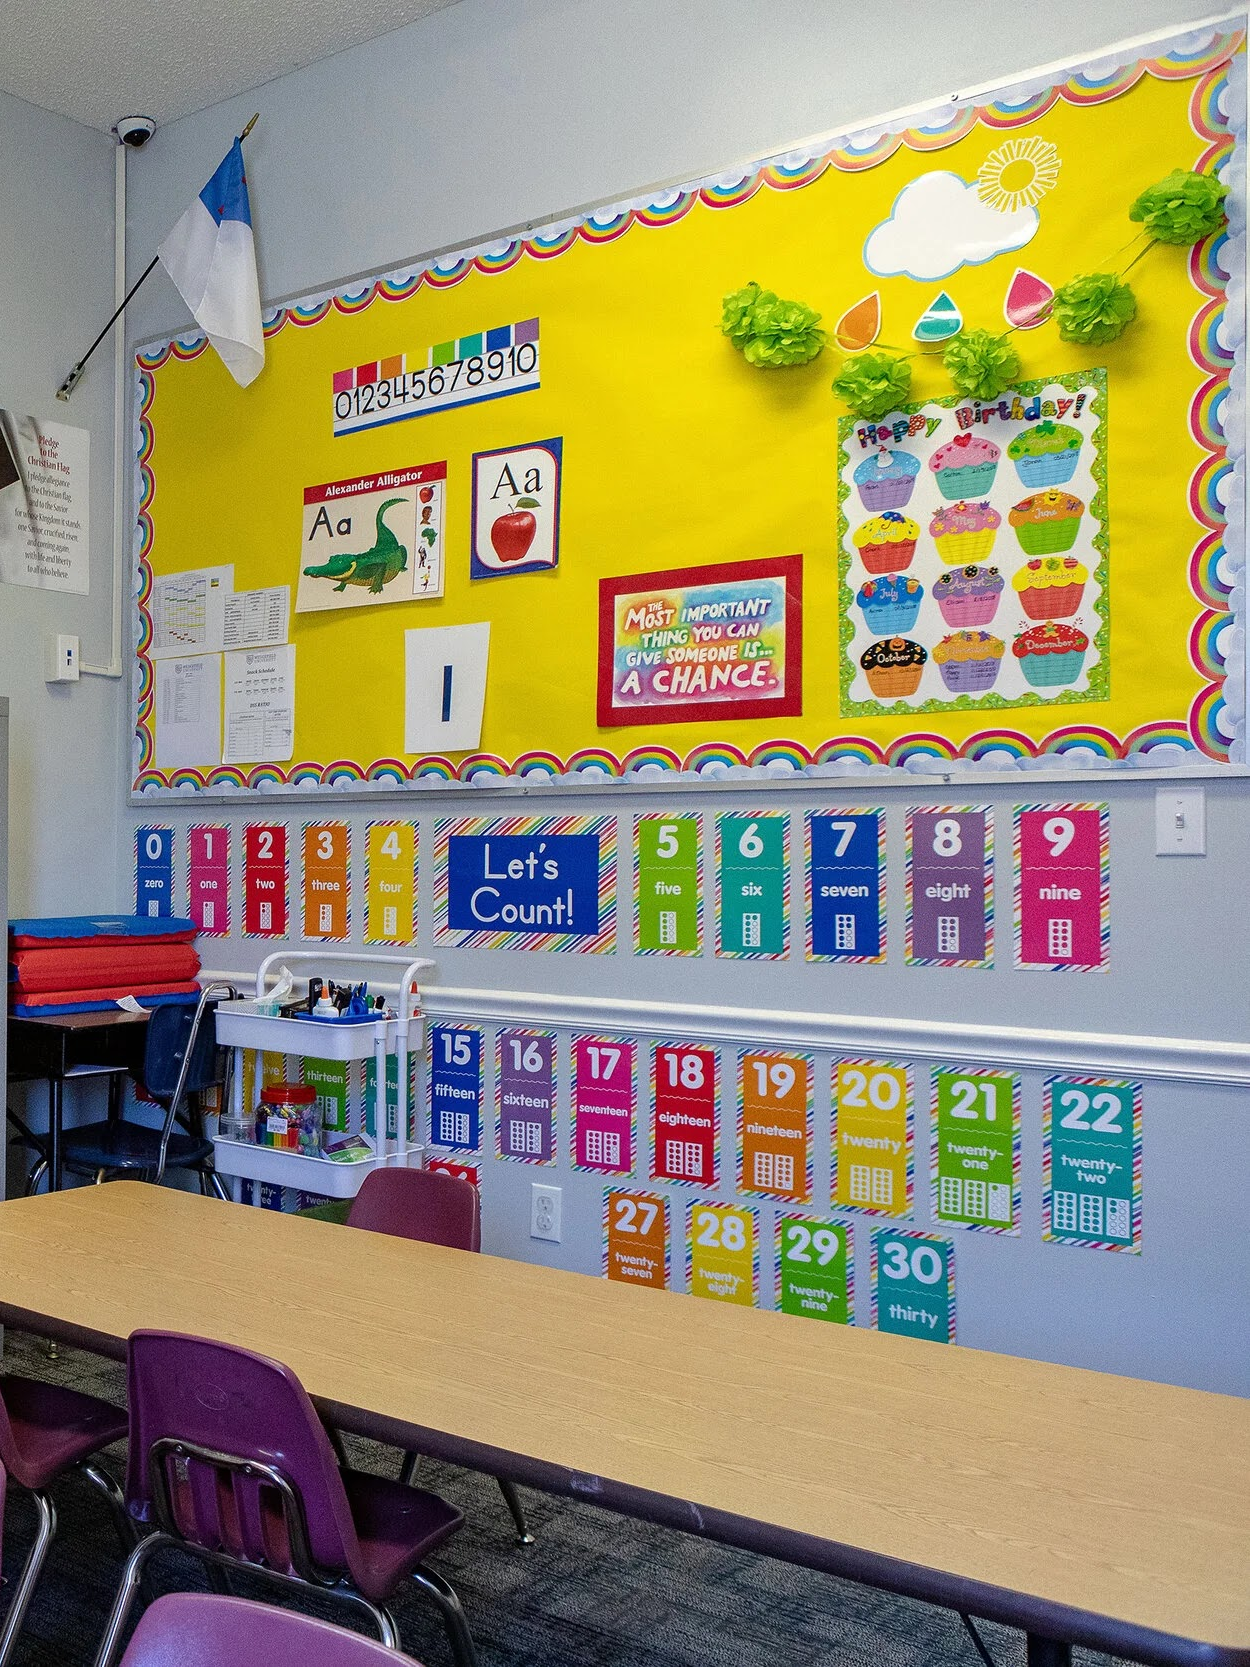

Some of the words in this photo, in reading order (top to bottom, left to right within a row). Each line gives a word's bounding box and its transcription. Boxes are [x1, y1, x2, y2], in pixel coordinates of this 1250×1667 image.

[857, 414, 942, 448] Happy
[955, 393, 1087, 430] Birthday!
[39, 435, 59, 449] Pledge
[40, 448, 47, 457] to
[48, 449, 59, 459] the
[27, 455, 57, 470] Christian
[57, 462, 70, 475] Flag
[325, 479, 374, 497] Alexander
[377, 470, 423, 489] Alligator
[490, 462, 543, 500] Aa
[309, 506, 352, 542] Aa
[952, 514, 977, 529] May
[1034, 508, 1057, 519] June
[872, 529, 898, 542] April
[949, 579, 985, 597] August
[1027, 572, 1077, 587] September
[880, 587, 899, 601] July
[624, 606, 675, 631] MOST
[681, 598, 772, 623] IMPORTANT
[648, 601, 663, 613] THE
[642, 629, 688, 648] THING
[692, 626, 722, 642] YOU
[726, 622, 760, 639] CAN
[1025, 639, 1073, 650] December
[625, 649, 662, 667] GIVE
[665, 644, 738, 664] SOMEONE
[743, 641, 773, 659] IS...
[877, 653, 911, 663] October
[620, 670, 641, 695] A
[652, 660, 776, 693] CHANCE.
[146, 833, 162, 860] 0
[203, 833, 213, 859] 1
[258, 831, 273, 859] 2
[317, 831, 334, 859] 3
[380, 831, 402, 860] 4
[656, 824, 679, 859] 5
[738, 823, 764, 859] 6
[830, 821, 857, 858] 7
[932, 819, 962, 857] 8
[1042, 817, 1075, 857] 9
[484, 843, 558, 880] Let's
[144, 878, 164, 889] zero
[200, 879, 218, 889] one
[255, 878, 275, 890] two
[312, 879, 340, 891] three
[379, 880, 402, 893] four
[654, 881, 682, 896] five
[741, 882, 763, 897] six
[820, 884, 869, 898] seven
[925, 883, 971, 901] eight
[1039, 884, 1082, 901] nine
[470, 886, 573, 926] Count!
[440, 1033, 472, 1066] 15
[509, 1039, 544, 1073] 16
[587, 1046, 622, 1080] 17
[663, 1053, 705, 1090] 18
[306, 1070, 343, 1084] thirteen
[752, 1061, 795, 1098] 19
[434, 1083, 476, 1100] fifteen
[503, 1093, 549, 1109] sixteen
[841, 1070, 901, 1111] 20
[950, 1080, 997, 1122] 21
[579, 1104, 628, 1118] seventeen
[658, 1111, 712, 1128] eighteen
[1060, 1089, 1122, 1134] 22
[746, 1122, 803, 1140] nineteen
[842, 1131, 902, 1153] twenty
[946, 1141, 1004, 1162] twenty-
[962, 1155, 990, 1171] one
[1060, 1153, 1123, 1174] twenty-
[1075, 1168, 1107, 1185] two
[615, 1199, 658, 1235] 27
[697, 1211, 746, 1252] 28
[786, 1225, 839, 1266] 29
[615, 1251, 658, 1270] twenty-
[883, 1241, 943, 1285] 30
[621, 1265, 653, 1280] seven
[698, 1266, 745, 1287] twenty-
[707, 1279, 738, 1297] eight
[788, 1282, 839, 1302] twenty-
[801, 1297, 828, 1313] nine
[888, 1303, 938, 1329] thirty
